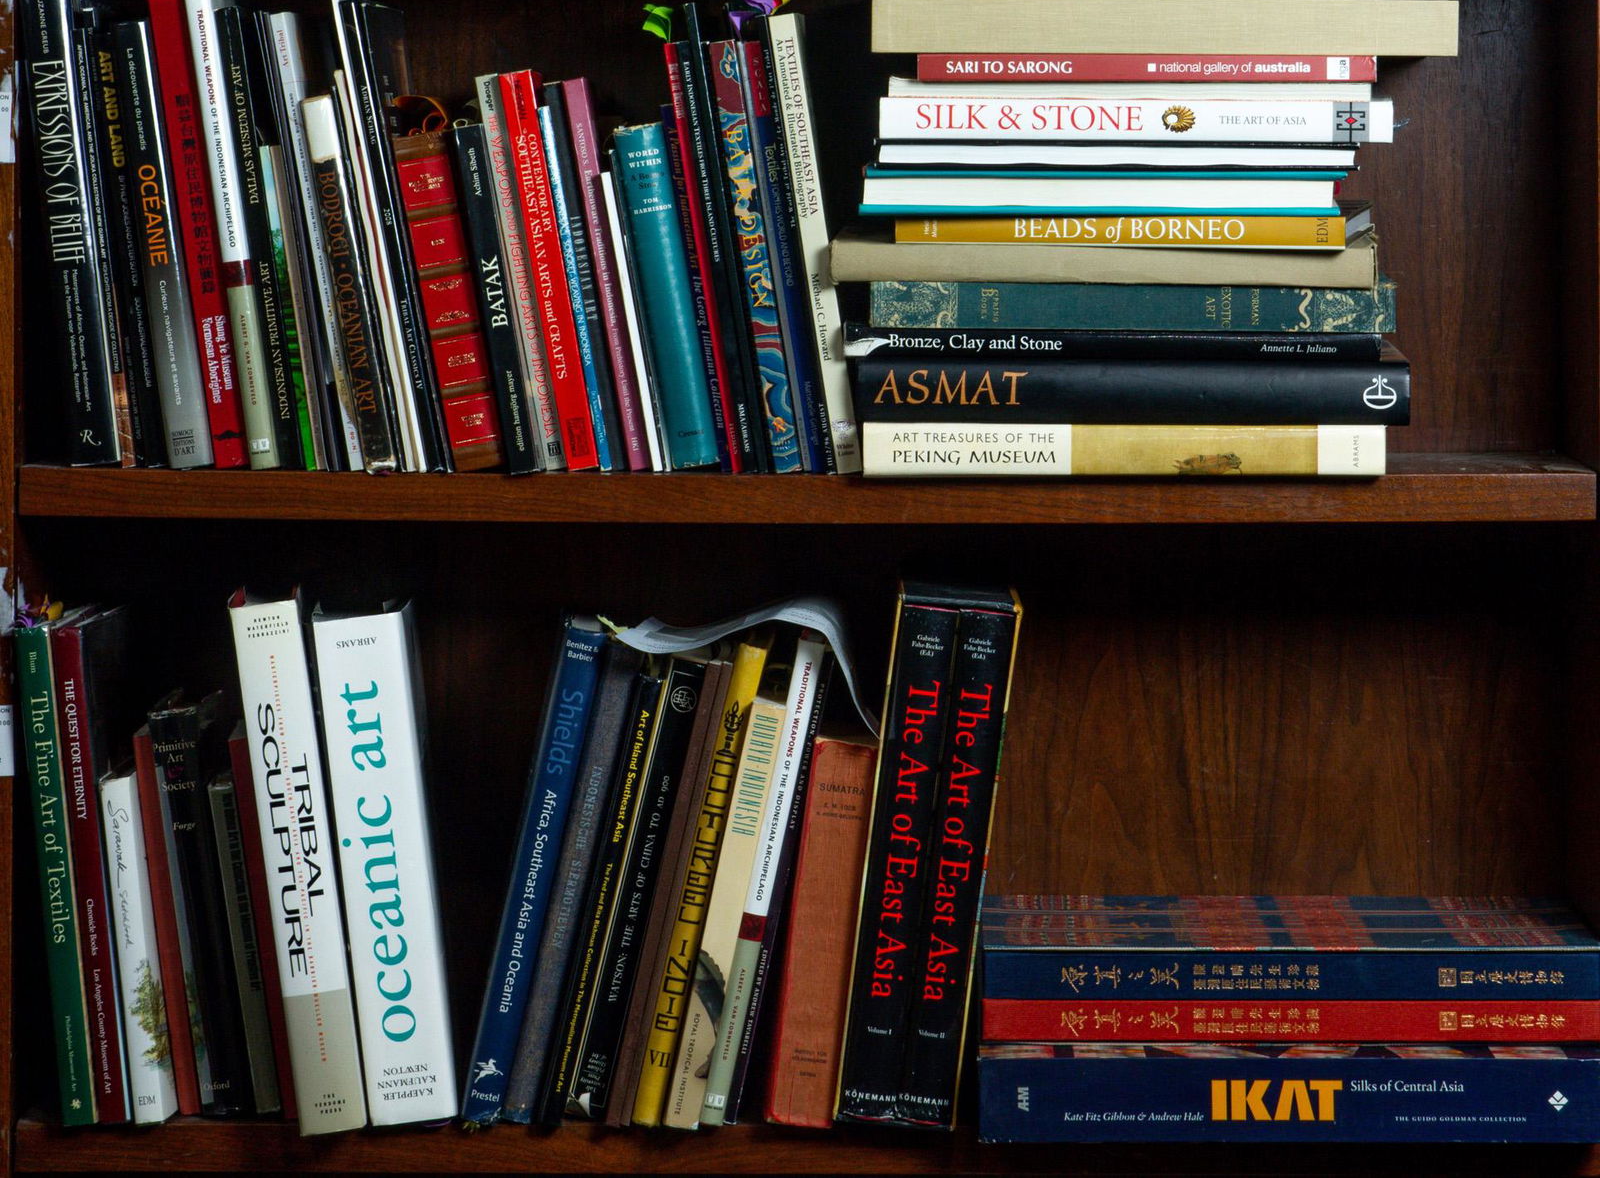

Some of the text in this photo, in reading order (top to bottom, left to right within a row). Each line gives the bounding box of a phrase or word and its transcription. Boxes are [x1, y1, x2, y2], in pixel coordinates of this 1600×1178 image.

[945, 61, 1073, 74] SARI TO SARONG
[1159, 62, 1310, 76] national gallery of australia
[916, 105, 1144, 132] SILK & STONE
[1219, 115, 1307, 126] THE ART OF ASIA
[32, 59, 86, 263] EXPRESSIONS OF BELIEF
[139, 164, 169, 267] OCÉANIE
[1014, 218, 1245, 241] BEADS of BORNEO
[482, 255, 508, 328] BATAK
[889, 335, 1062, 351] Bronze, Clay and Stone
[1260, 343, 1297, 352] Annette
[1306, 344, 1337, 354] Juliano
[875, 370, 1029, 406] ASMAT
[892, 433, 1055, 444] ART TREASURES OF THE
[892, 449, 1056, 467] PEKING MUSEUM
[336, 636, 377, 649] ABRAMS
[31, 691, 69, 944] The Fine Art of Textiles
[257, 702, 308, 976] SCULPTURE
[292, 752, 324, 917] TRIBAL
[872, 680, 940, 998] The Art of East Asia
[923, 683, 993, 1001] The Art of East Asia
[340, 680, 416, 1043] oceanic art
[500, 689, 584, 1013] Shields Africa, Southeast Asia and Oceania
[1350, 1080, 1464, 1093] Silks of Central Asia
[138, 1095, 155, 1106] EDM
[1211, 1079, 1343, 1122] IKAT
[1064, 1112, 1204, 1123] Kate Fitz Gibbon & Andrew Hale
